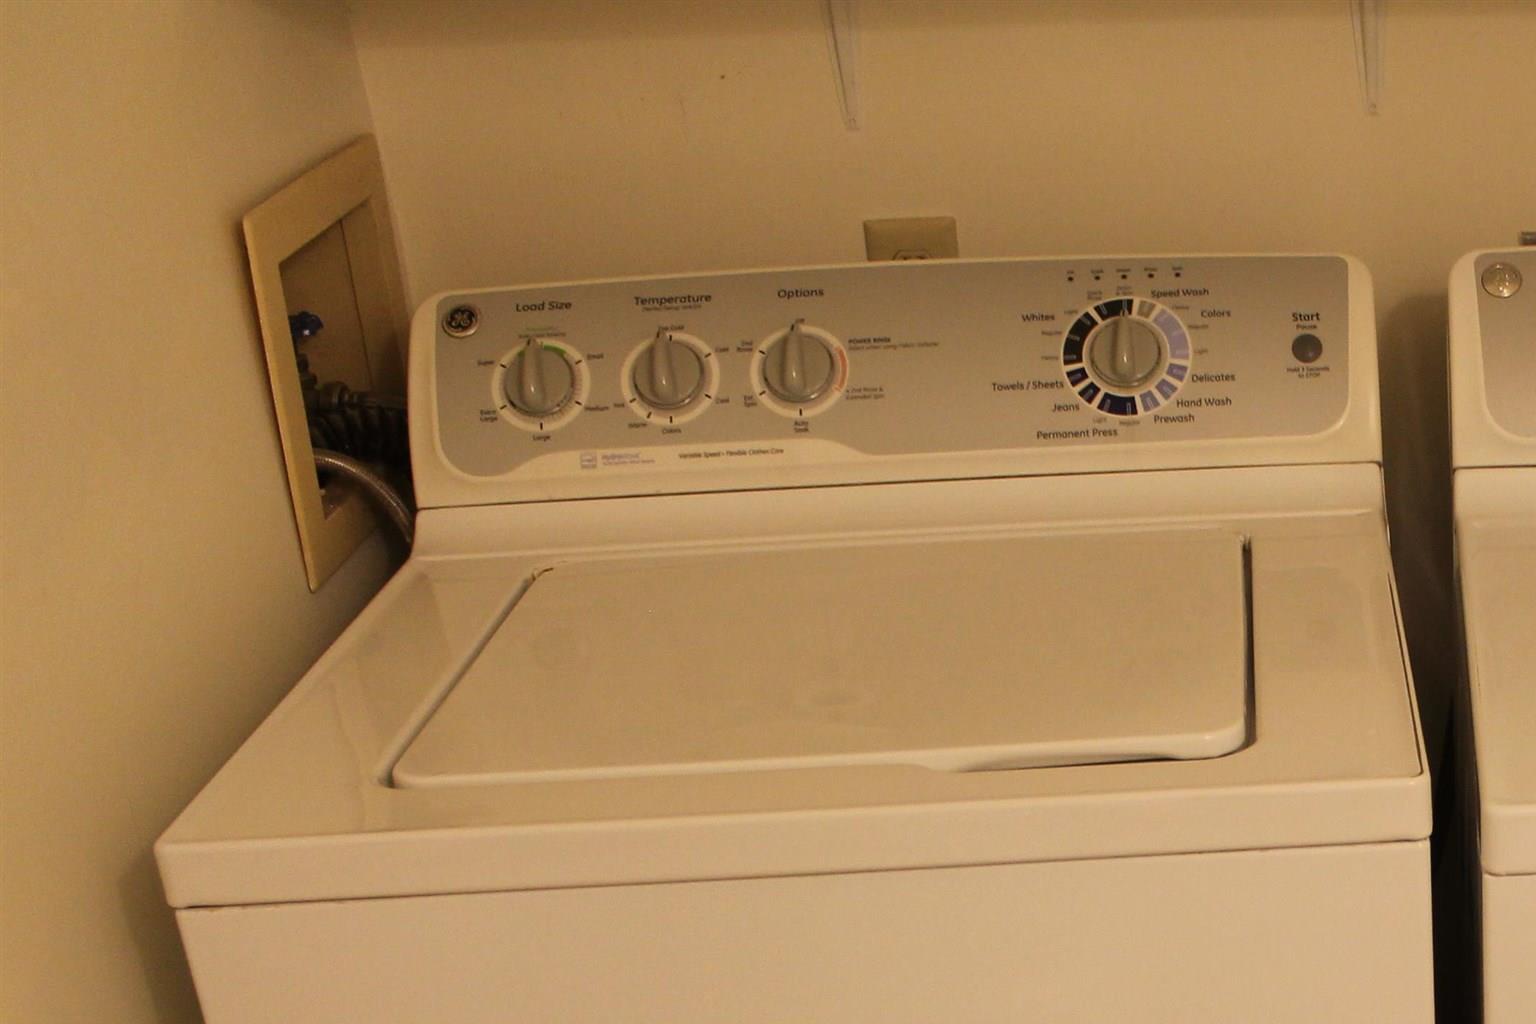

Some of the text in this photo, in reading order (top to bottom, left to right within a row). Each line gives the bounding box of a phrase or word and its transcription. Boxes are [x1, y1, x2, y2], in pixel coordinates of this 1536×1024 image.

[777, 288, 825, 300] Options
[1151, 288, 1209, 299] Speed Wash
[634, 294, 712, 306] Temperature
[515, 301, 572, 313] Load Size
[1021, 312, 1055, 322] Whites
[1201, 309, 1231, 318] Colors
[1291, 312, 1321, 322] Start
[1191, 372, 1236, 383] Delicates
[992, 382, 1025, 391] Towels
[1032, 380, 1064, 390] Sheets
[1052, 403, 1080, 413] Jeans
[1176, 398, 1232, 408] Hand Wash
[1154, 414, 1195, 424] Prewash
[1036, 428, 1118, 441] Permanent Press
